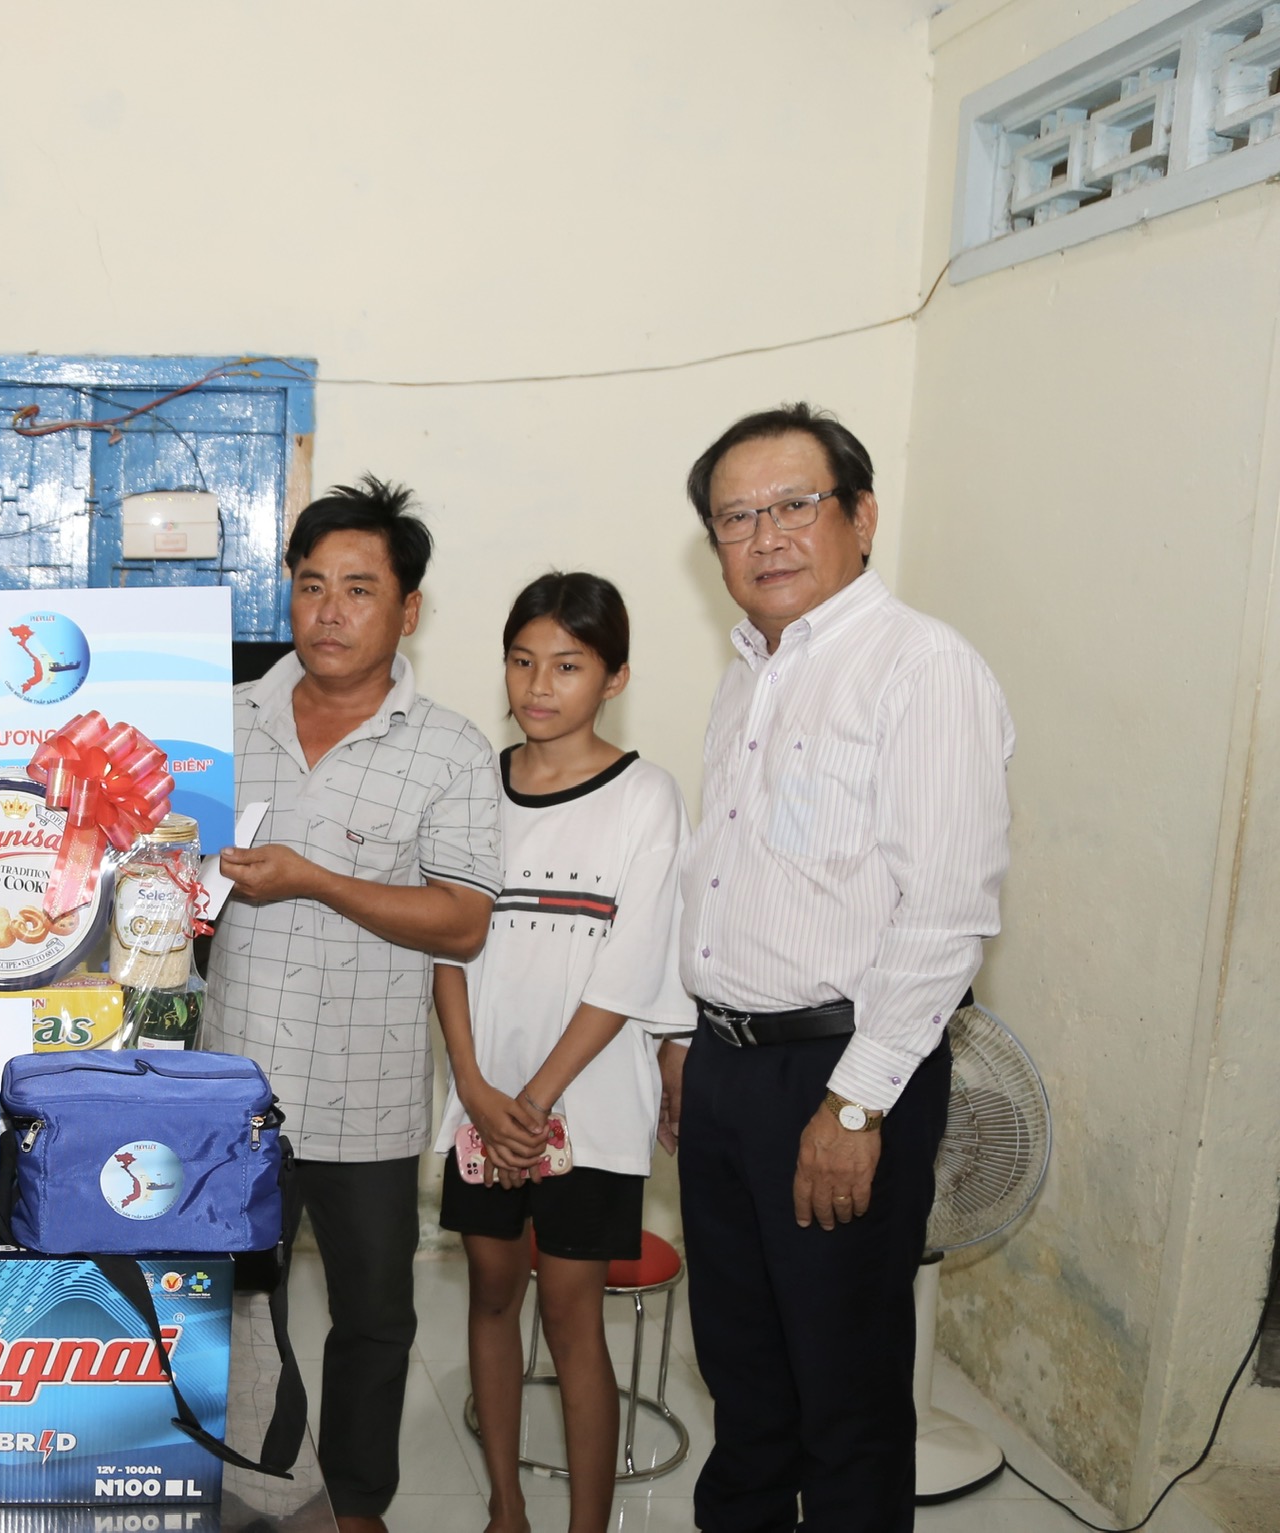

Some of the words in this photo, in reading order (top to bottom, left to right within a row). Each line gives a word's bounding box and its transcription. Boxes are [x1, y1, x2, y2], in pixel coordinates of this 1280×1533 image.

[504, 870, 601, 883] OMMY
[22, 955, 46, 966] NETTO
[96, 1465, 116, 1474] 12V
[124, 1465, 162, 1475] 100Ah
[94, 1478, 161, 1497] N100
[186, 1479, 202, 1497] L
